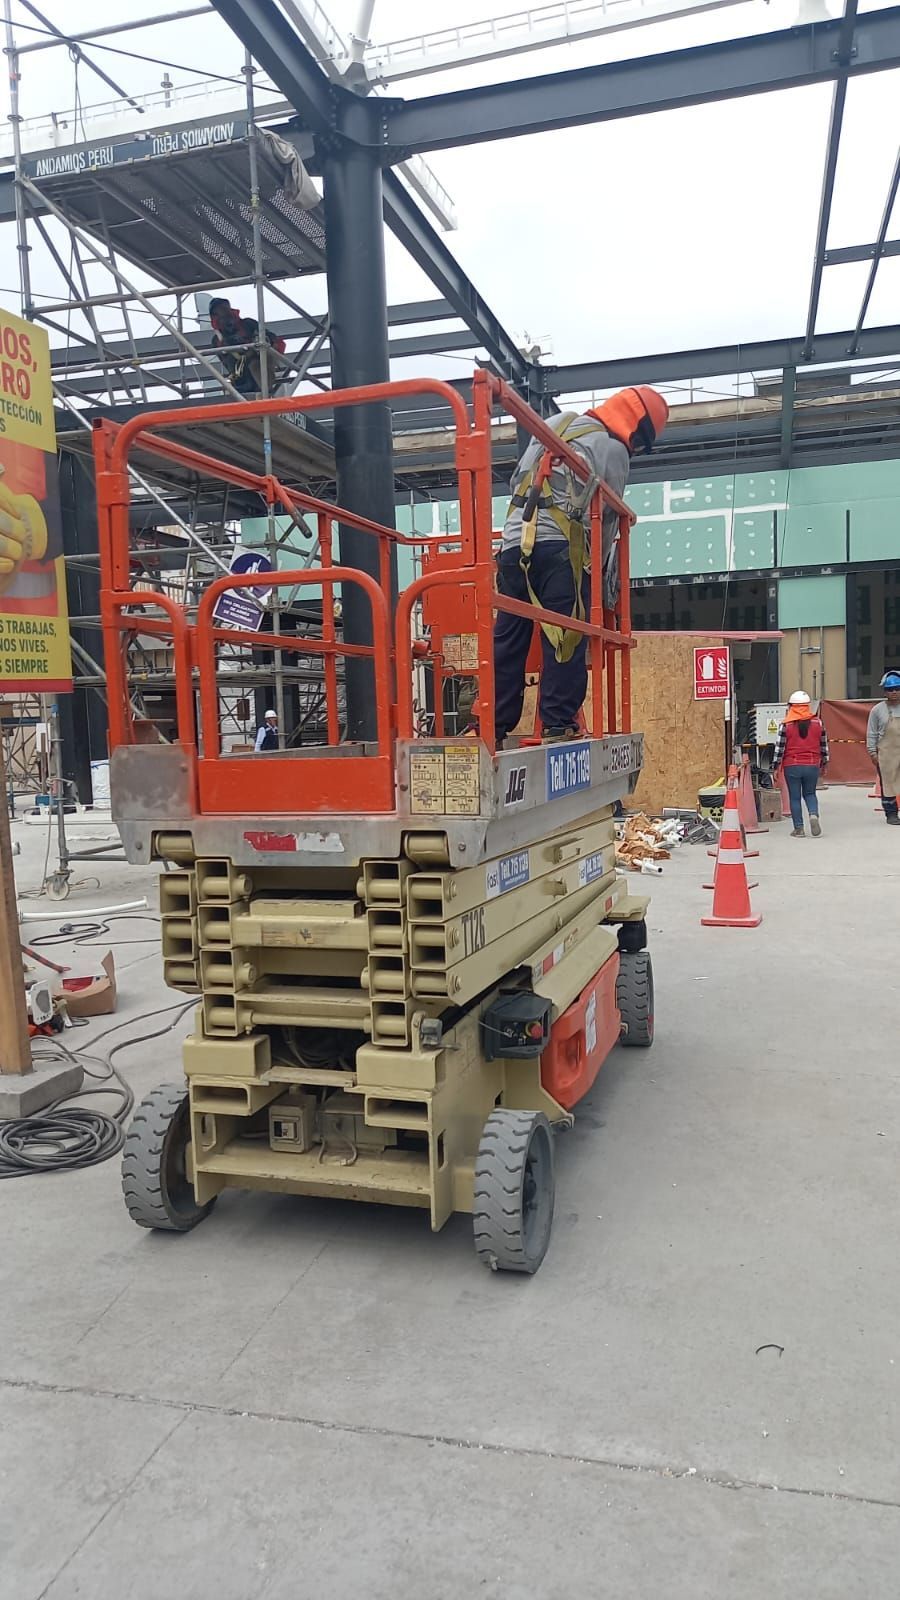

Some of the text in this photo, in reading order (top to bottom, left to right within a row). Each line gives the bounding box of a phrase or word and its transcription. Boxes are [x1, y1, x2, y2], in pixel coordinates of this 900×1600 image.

[152, 121, 234, 154] ANDAMIOS PERU
[36, 146, 114, 177] ANDAMIOS PERU
[0, 326, 37, 372] OS,
[6, 620, 57, 637] TRABAJAS,
[18, 639, 49, 653] VIVES.
[5, 658, 49, 674] SIEMPRE
[697, 685, 727, 694] EXTINTOR
[565, 751, 577, 788] 715
[577, 748, 590, 784] 1139
[504, 766, 527, 806] JLG
[461, 906, 486, 957] T126
